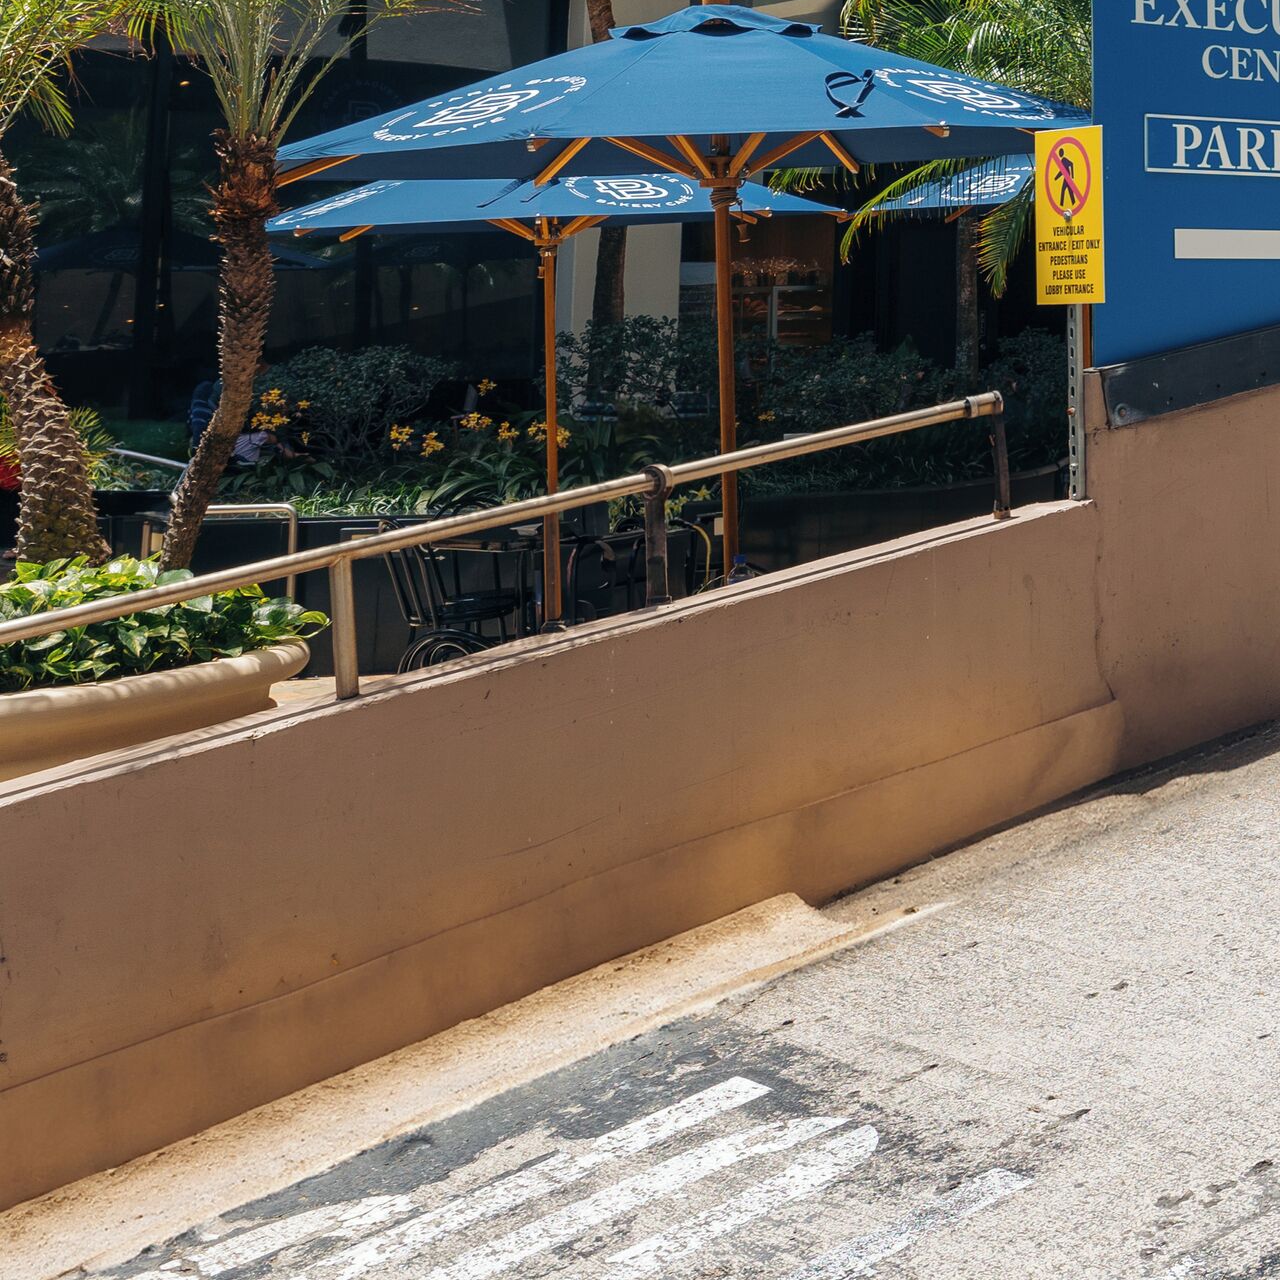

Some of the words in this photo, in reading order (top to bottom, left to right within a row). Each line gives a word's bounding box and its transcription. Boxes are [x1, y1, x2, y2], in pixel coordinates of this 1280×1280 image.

[1052, 225, 1085, 237] VEHICULAR
[1038, 240, 1067, 252] ENTRANCE
[1072, 239, 1085, 250] EXIT
[1086, 239, 1101, 249] ONLY
[1050, 254, 1088, 266] PEDESTRIANS
[1052, 270, 1073, 280] PLEASE
[1075, 269, 1086, 279] USE
[1045, 285, 1063, 295] LOBBY
[1064, 284, 1095, 295] ENTRANCE
